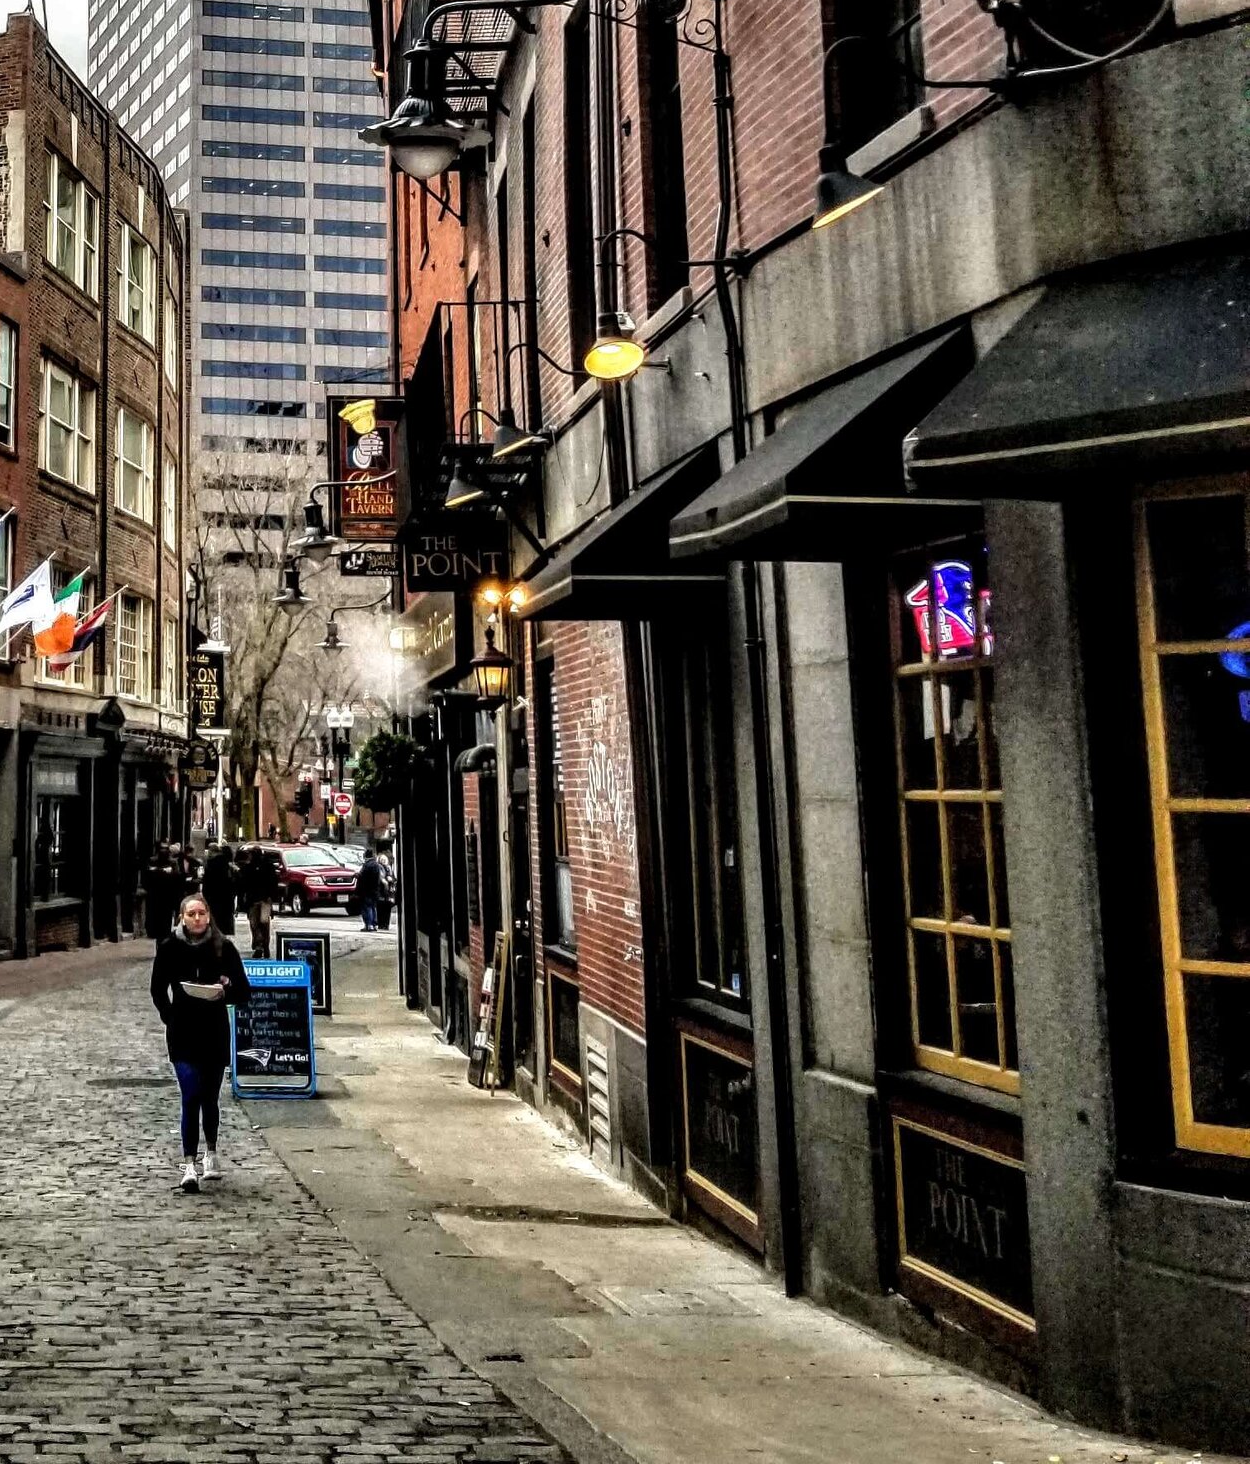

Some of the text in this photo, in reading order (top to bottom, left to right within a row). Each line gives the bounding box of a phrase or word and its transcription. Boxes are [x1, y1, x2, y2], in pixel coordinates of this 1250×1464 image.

[346, 497, 394, 515] TAVERN
[420, 535, 458, 552] THE
[411, 547, 503, 580] POINT
[266, 966, 301, 978] LIGHT
[275, 1053, 309, 1062] Let's Go!
[927, 1181, 1006, 1260] POINT
